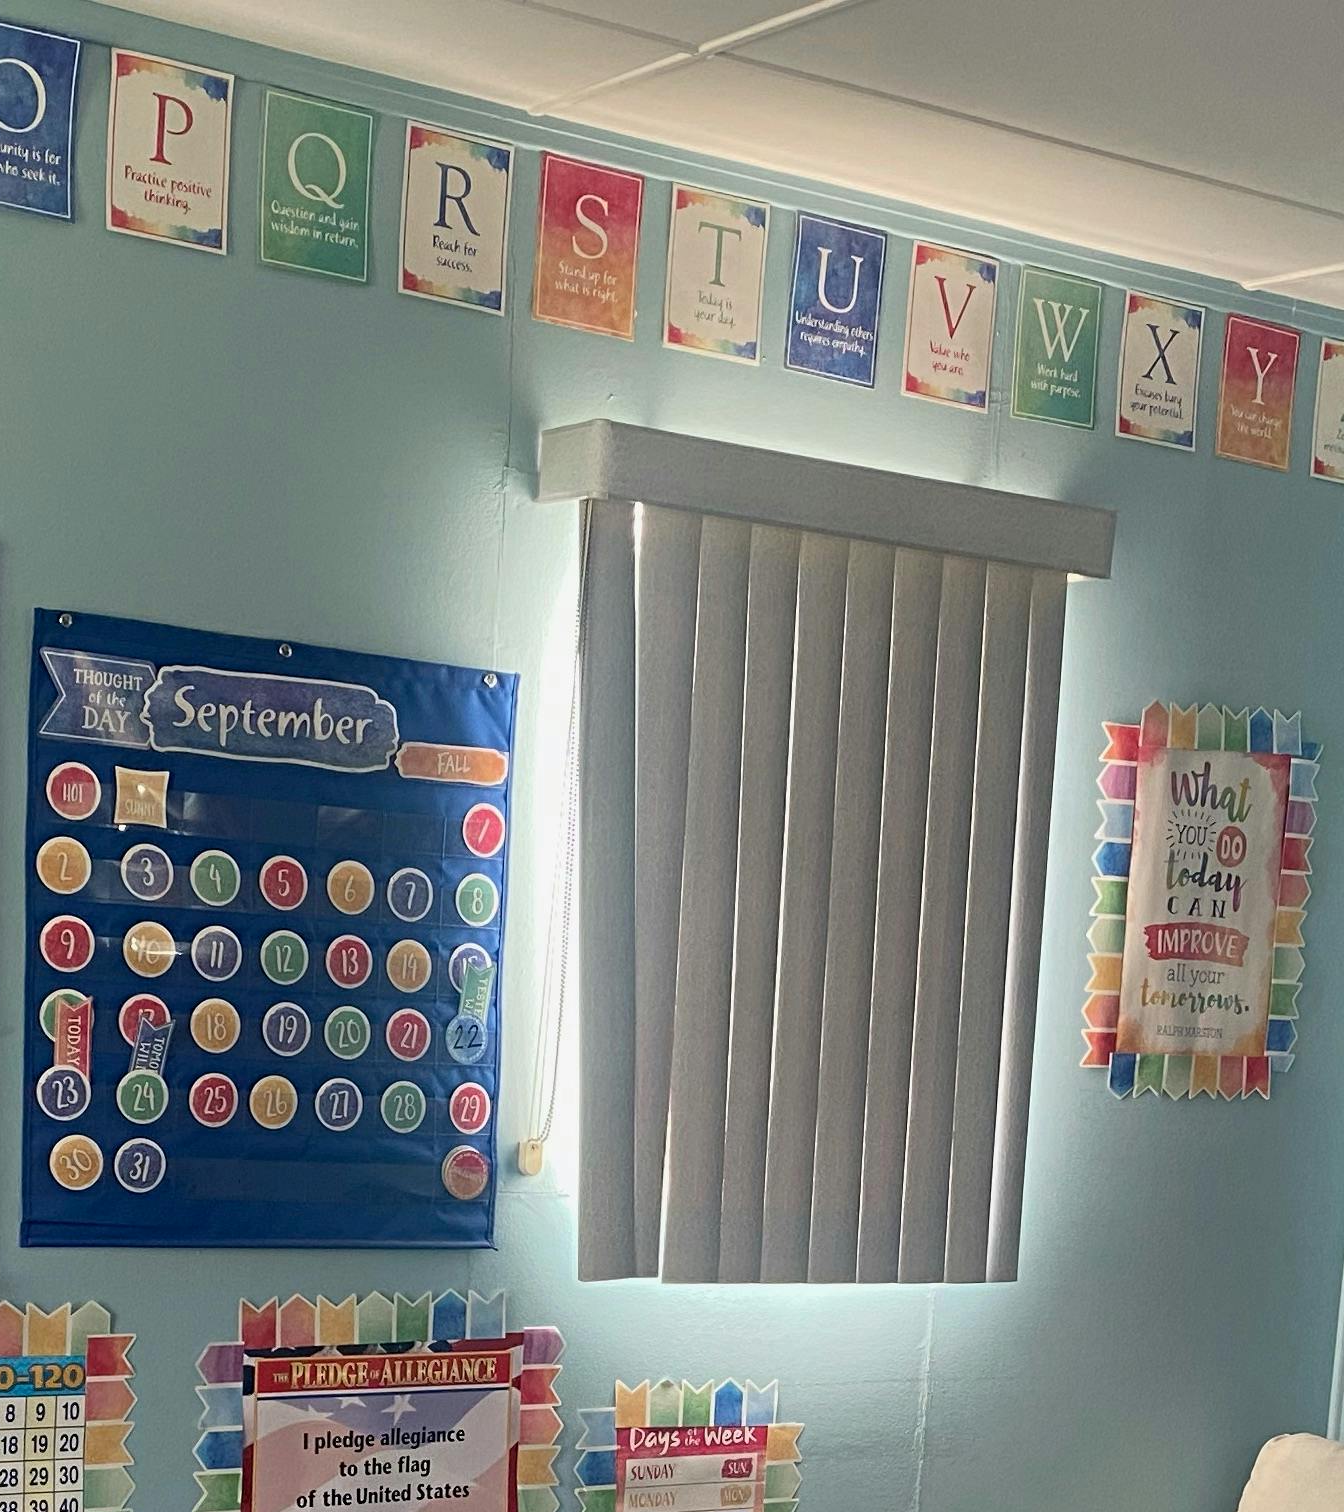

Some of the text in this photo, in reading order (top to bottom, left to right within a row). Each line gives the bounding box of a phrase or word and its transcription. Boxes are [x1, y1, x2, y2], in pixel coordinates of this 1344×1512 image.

[148, 91, 194, 166] P
[32, 145, 42, 162] is
[44, 149, 62, 166] for
[20, 166, 46, 184] seek
[123, 164, 213, 198] Practice positive
[287, 132, 347, 209] Q
[144, 189, 192, 214] thinking.
[432, 161, 482, 237] R
[571, 194, 609, 260] S
[698, 221, 742, 288] T
[816, 246, 864, 314] U
[934, 275, 977, 341] V
[1033, 298, 1090, 363] W
[1141, 323, 1180, 385] X
[1246, 346, 1279, 406] Y
[73, 667, 144, 692] THOUGHT
[88, 691, 127, 708] of the
[82, 705, 129, 734] DAY
[173, 685, 374, 747] September
[437, 752, 471, 774] FALL
[62, 783, 85, 803] HOT
[1171, 761, 1253, 824] What
[1175, 821, 1244, 860] YOU DO
[277, 868, 291, 897] 5
[1165, 848, 1248, 913] today
[1157, 927, 1239, 960] IMPROVE
[342, 948, 359, 977] 13
[1167, 963, 1225, 986] all your
[1141, 976, 1250, 1016] tomorrows.
[67, 1016, 81, 1066] TODAY
[453, 1024, 483, 1050] 22
[203, 1084, 227, 1116] 25
[289, 1361, 368, 1388] PLEDGE
[380, 1358, 498, 1385] ALLEGIANCE
[61, 1401, 80, 1422] 10
[303, 1428, 466, 1454] I pledge allegiance
[629, 1427, 681, 1455] Days
[684, 1436, 700, 1447] the
[703, 1426, 757, 1446] Week
[339, 1456, 431, 1479] to the flag
[630, 1463, 677, 1481] SUNDAY
[296, 1482, 470, 1509] of the United States
